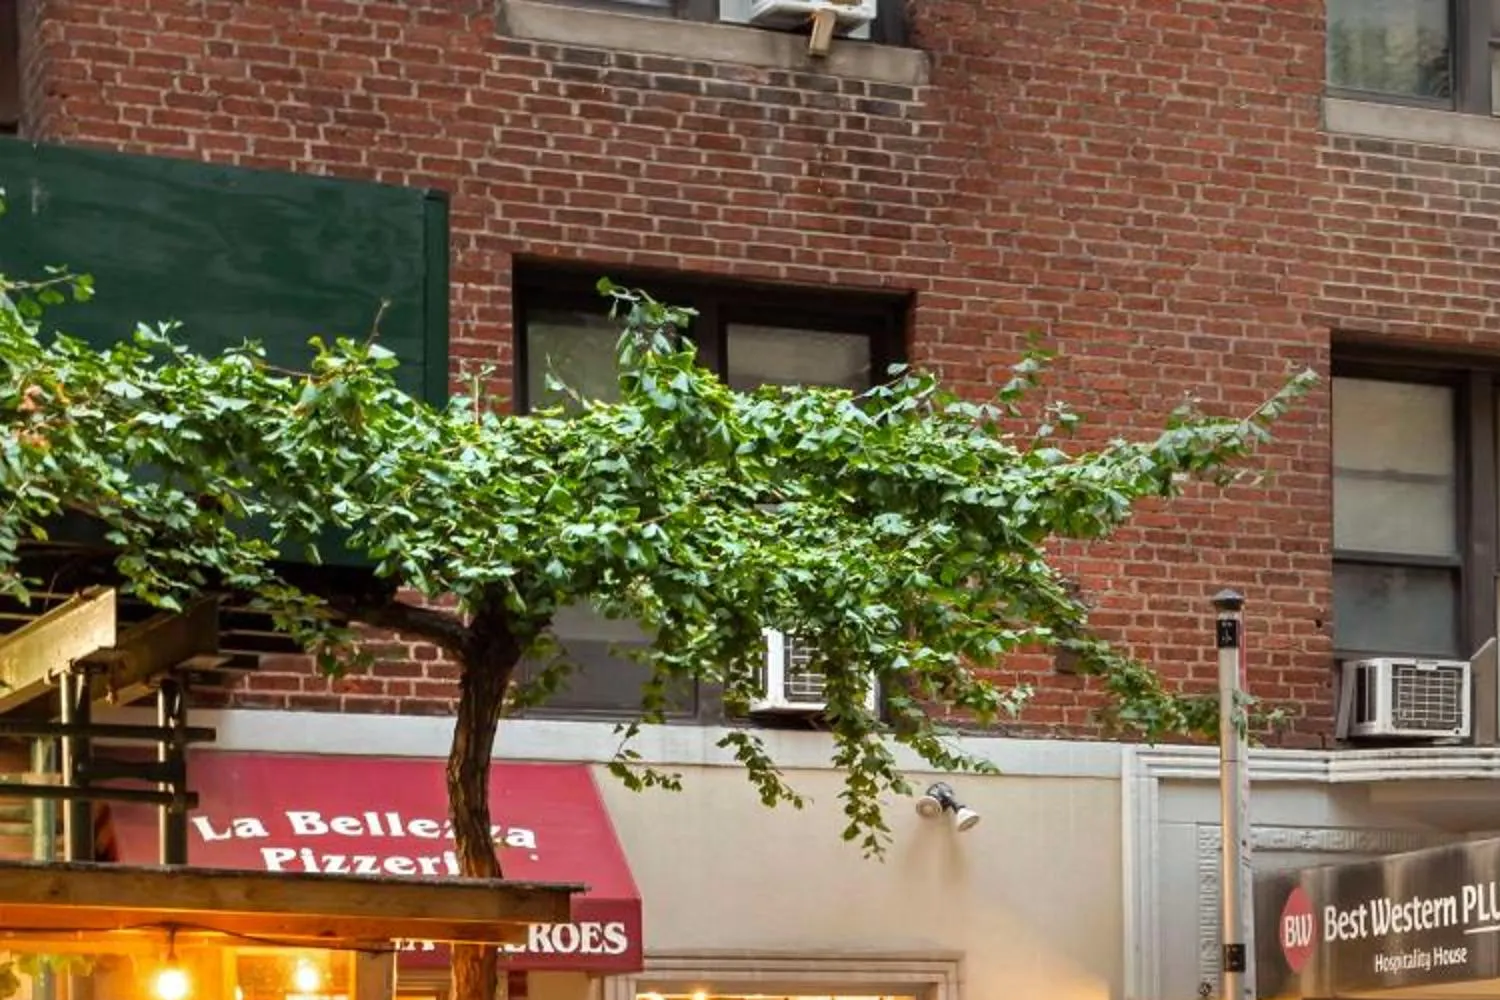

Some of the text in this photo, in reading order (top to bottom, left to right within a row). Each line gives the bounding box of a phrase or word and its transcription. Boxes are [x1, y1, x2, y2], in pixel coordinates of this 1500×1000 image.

[191, 816, 270, 842] La
[260, 847, 462, 875] Pizzeri
[1284, 913, 1313, 948] BW
[1324, 905, 1368, 942] Best
[1370, 895, 1459, 936] Western
[498, 922, 629, 954] ROES
[1374, 947, 1468, 974] Hospitality House
